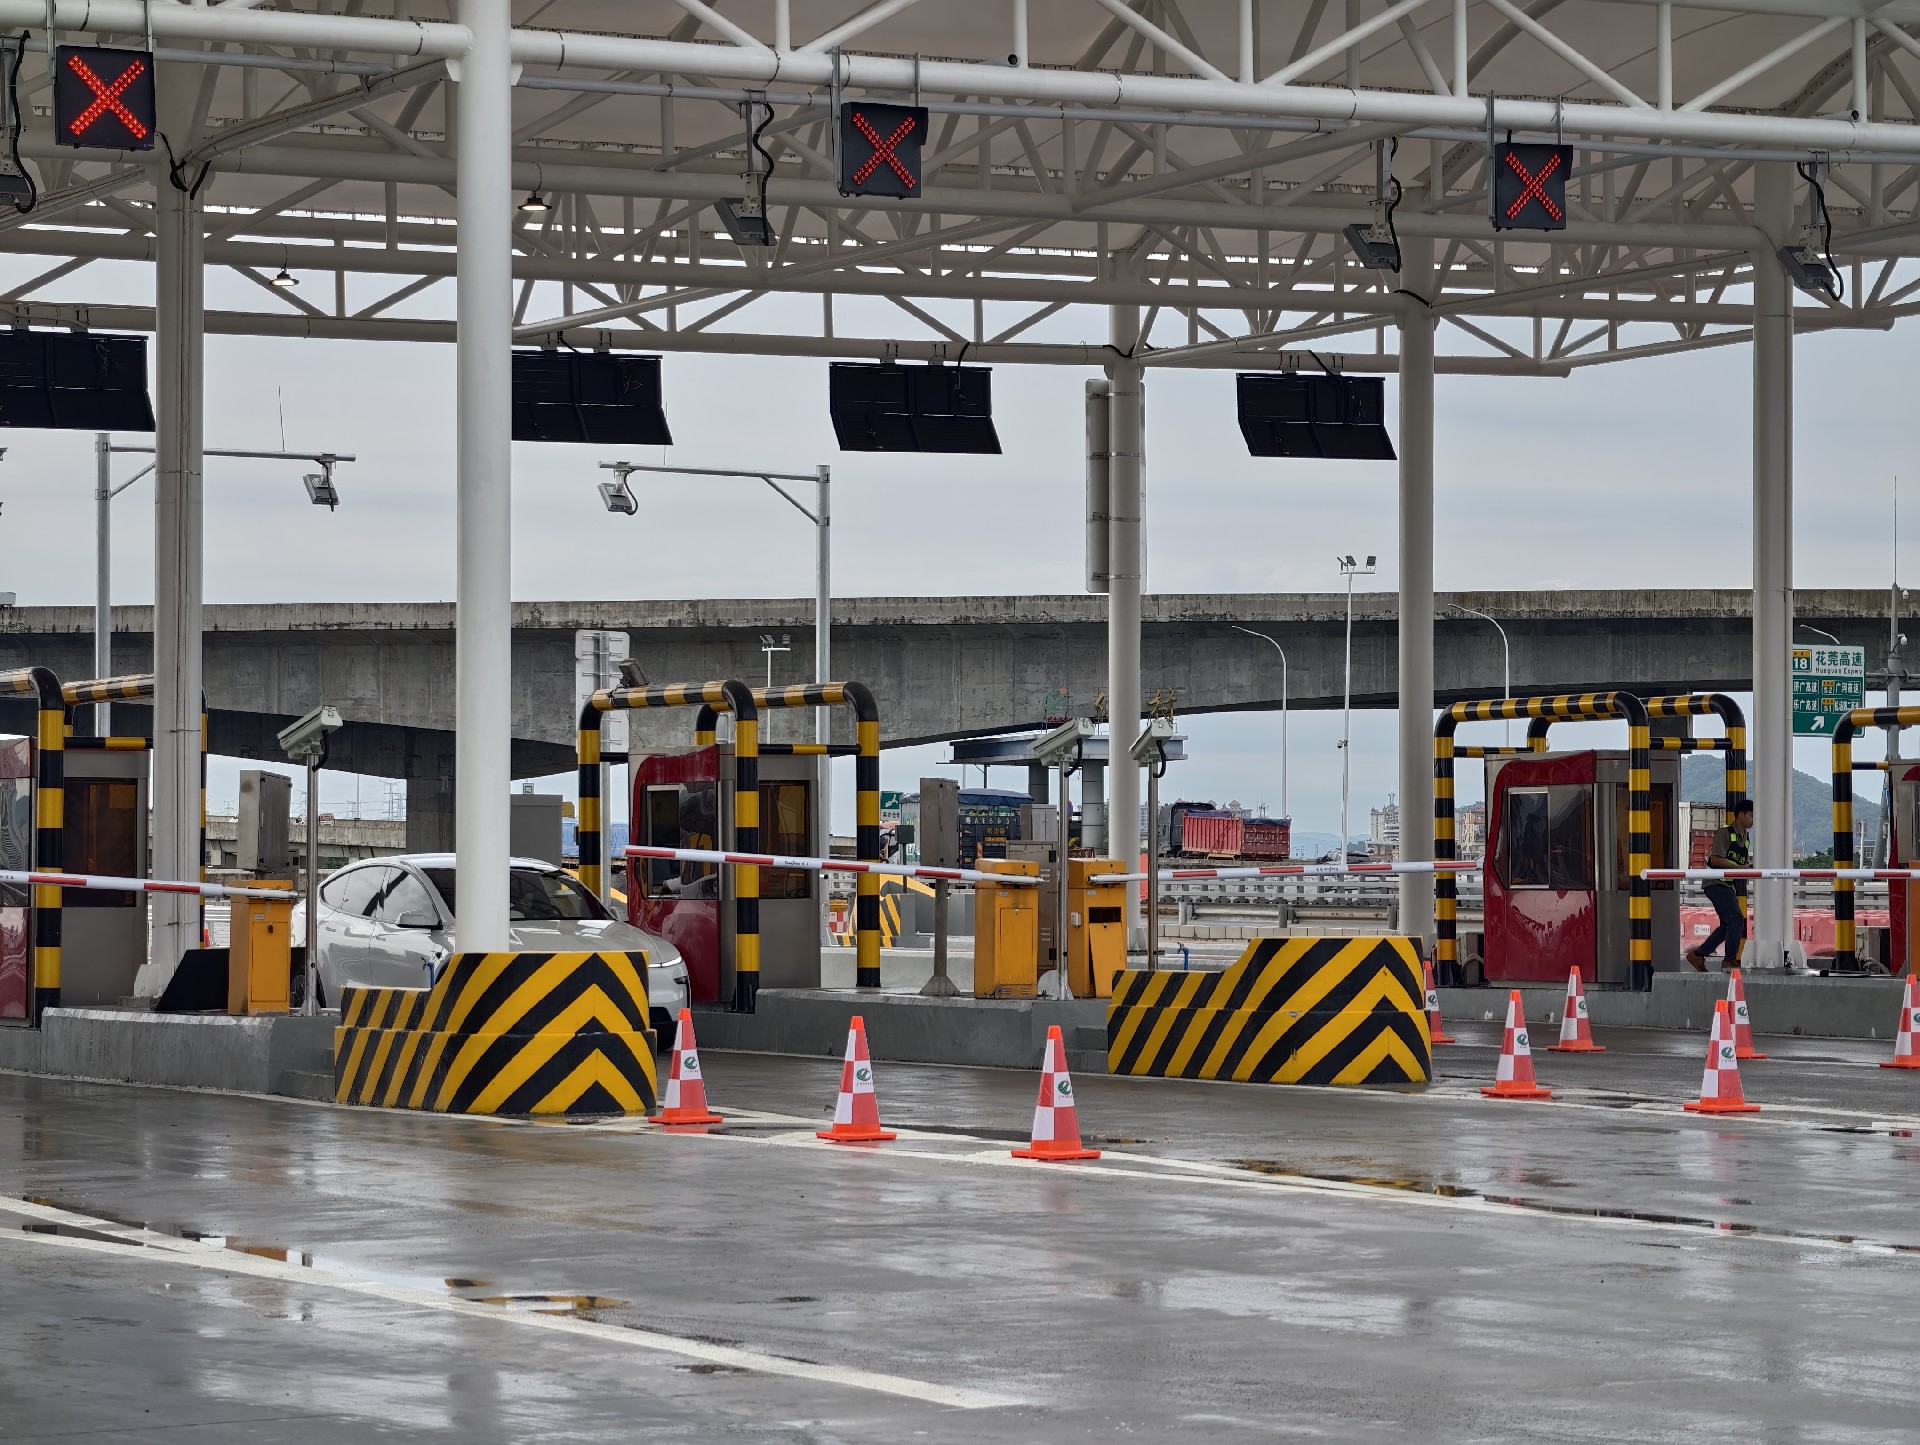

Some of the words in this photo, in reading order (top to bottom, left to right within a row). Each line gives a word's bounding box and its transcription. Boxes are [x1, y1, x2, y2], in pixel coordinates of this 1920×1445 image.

[1815, 651, 1863, 666] 花莞高速
[1843, 668, 1863, 676] Expwy
[1793, 699, 1818, 711] 乐广高速
